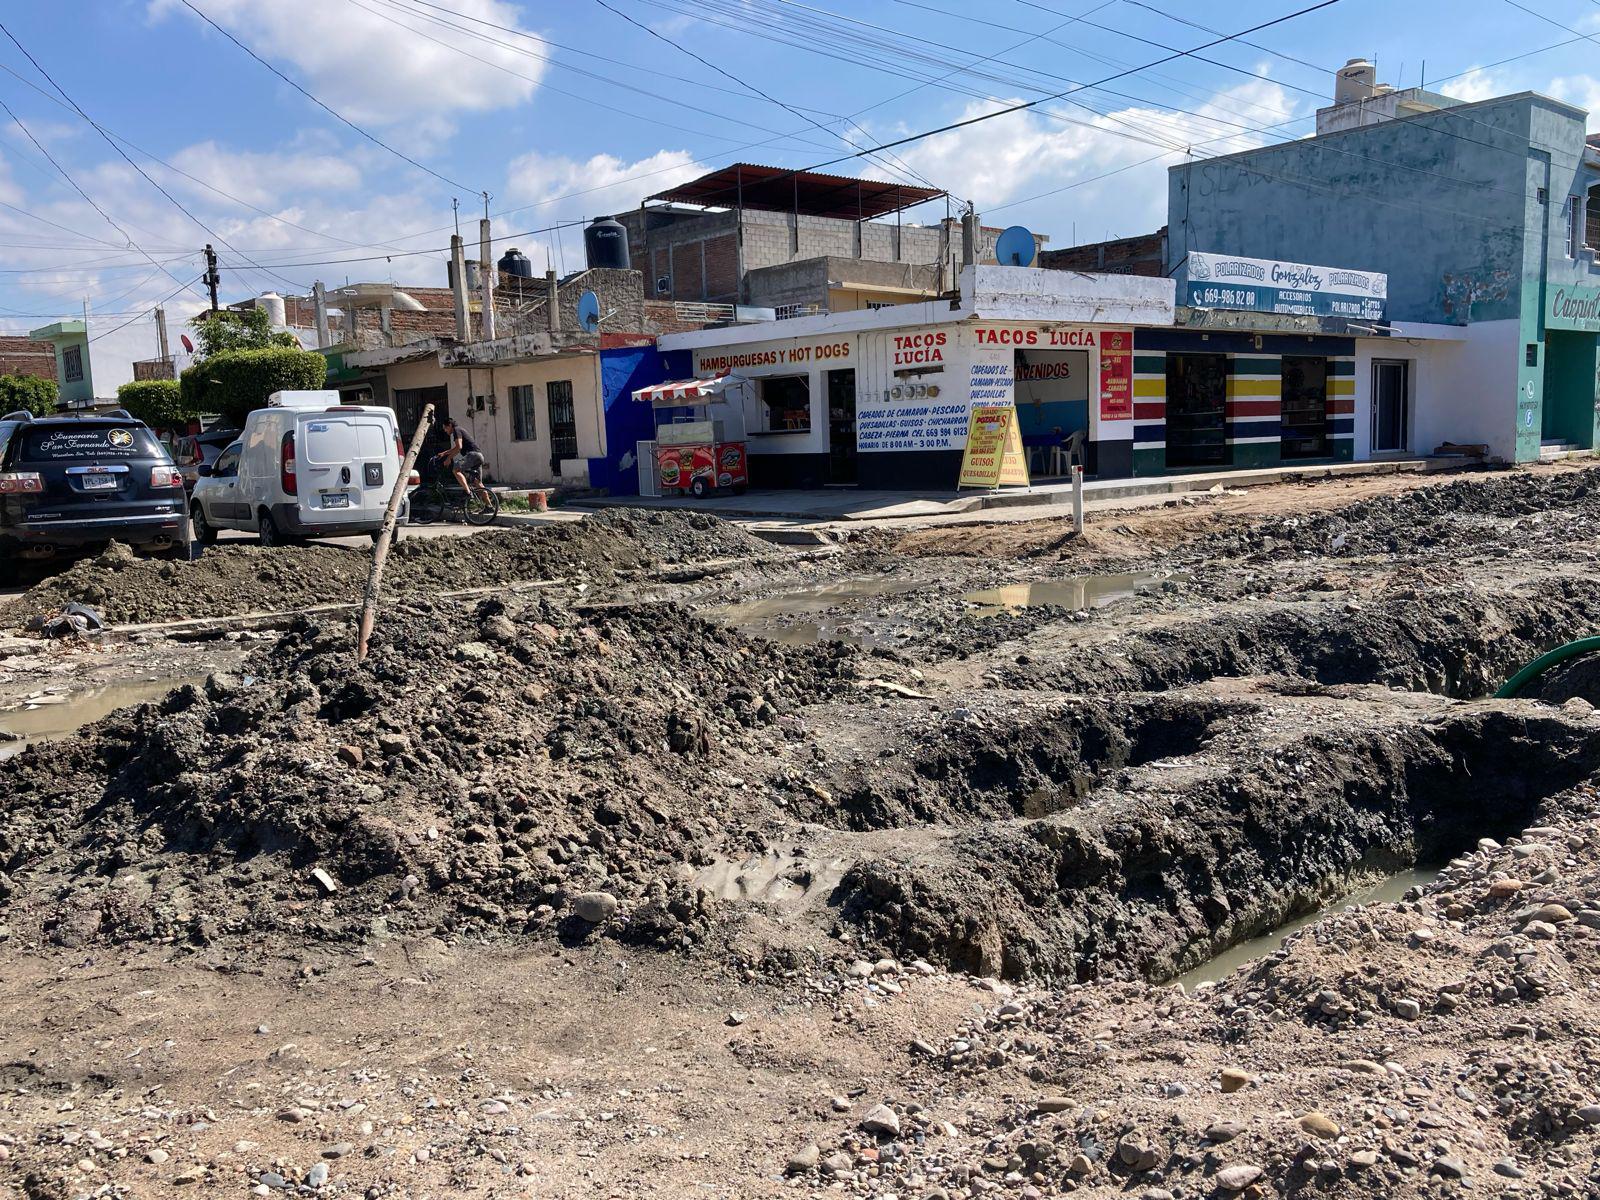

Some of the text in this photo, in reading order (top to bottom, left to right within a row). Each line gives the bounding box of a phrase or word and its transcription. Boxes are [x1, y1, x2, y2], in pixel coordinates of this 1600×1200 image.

[1215, 262, 1265, 281] POLARIZADOS
[1329, 272, 1369, 289] POLARIZADOS
[1236, 290, 1244, 304] 82
[1278, 290, 1312, 302] ACCESORIOS
[1274, 304, 1315, 314] AUTOMOTRICES
[1332, 301, 1360, 314] POLARIZADO
[894, 332, 946, 350] TACOS
[975, 328, 1096, 346] TACOS LUCÍA
[700, 342, 850, 371] HAMBURGUESAS Y HOT DOGS
[894, 347, 943, 365] LUCÍA
[971, 365, 1008, 374] CAPEADOS DE
[970, 390, 1006, 400] QUESADILLAS
[858, 410, 884, 420] CAPEADOS
[886, 410, 895, 418] DE
[51, 432, 99, 440] Funeraria
[926, 429, 938, 437] 669
[953, 426, 968, 436] 6123
[40, 440, 110, 451] San Fernando
[859, 441, 879, 449] HORARIO
[936, 439, 951, 447] P.M.
[971, 458, 994, 466] GUISOS
[963, 470, 996, 478] QUESADILLAS
